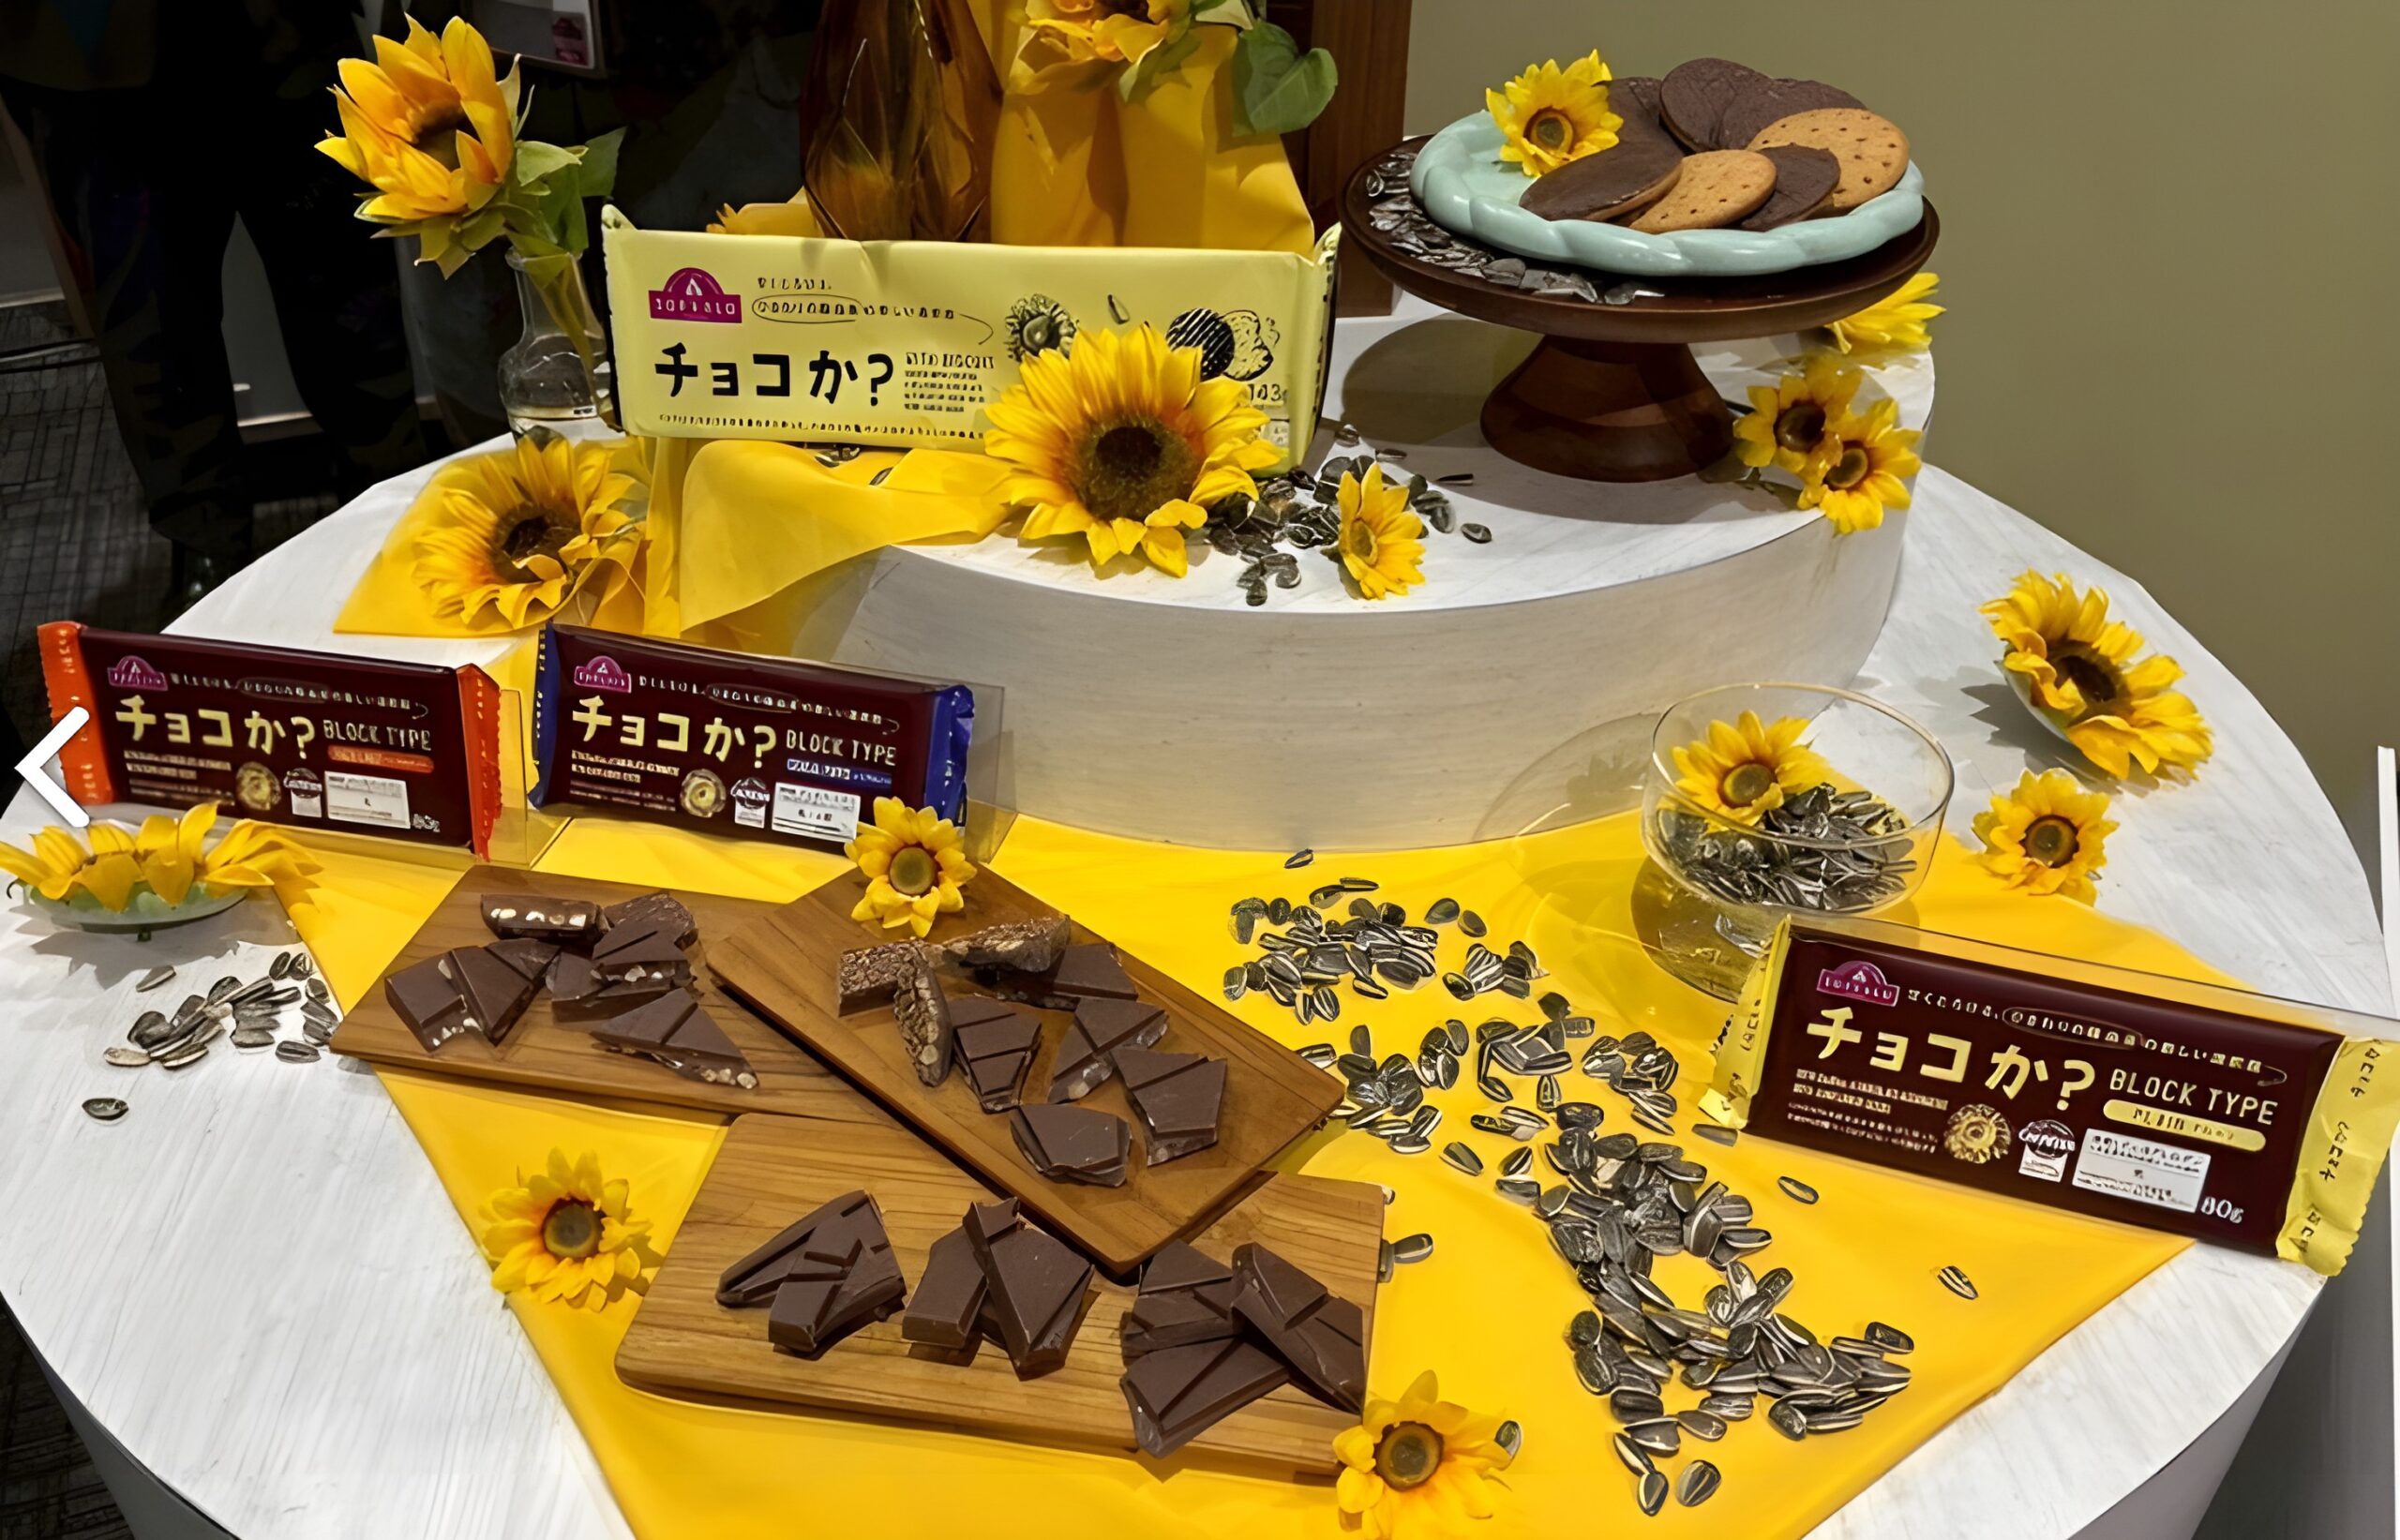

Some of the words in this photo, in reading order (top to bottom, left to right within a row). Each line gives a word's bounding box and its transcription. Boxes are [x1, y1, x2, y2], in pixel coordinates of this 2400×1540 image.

[654, 341, 894, 407] チョコか?
[114, 695, 315, 760] チョコか?
[572, 695, 777, 769] チョコか?
[786, 728, 844, 757] BLOCK
[852, 740, 897, 767] TYPE
[1806, 1006, 2096, 1112] チョコか?
[2109, 1068, 2198, 1107] BLOCK
[2208, 1086, 2279, 1126] TYPE
